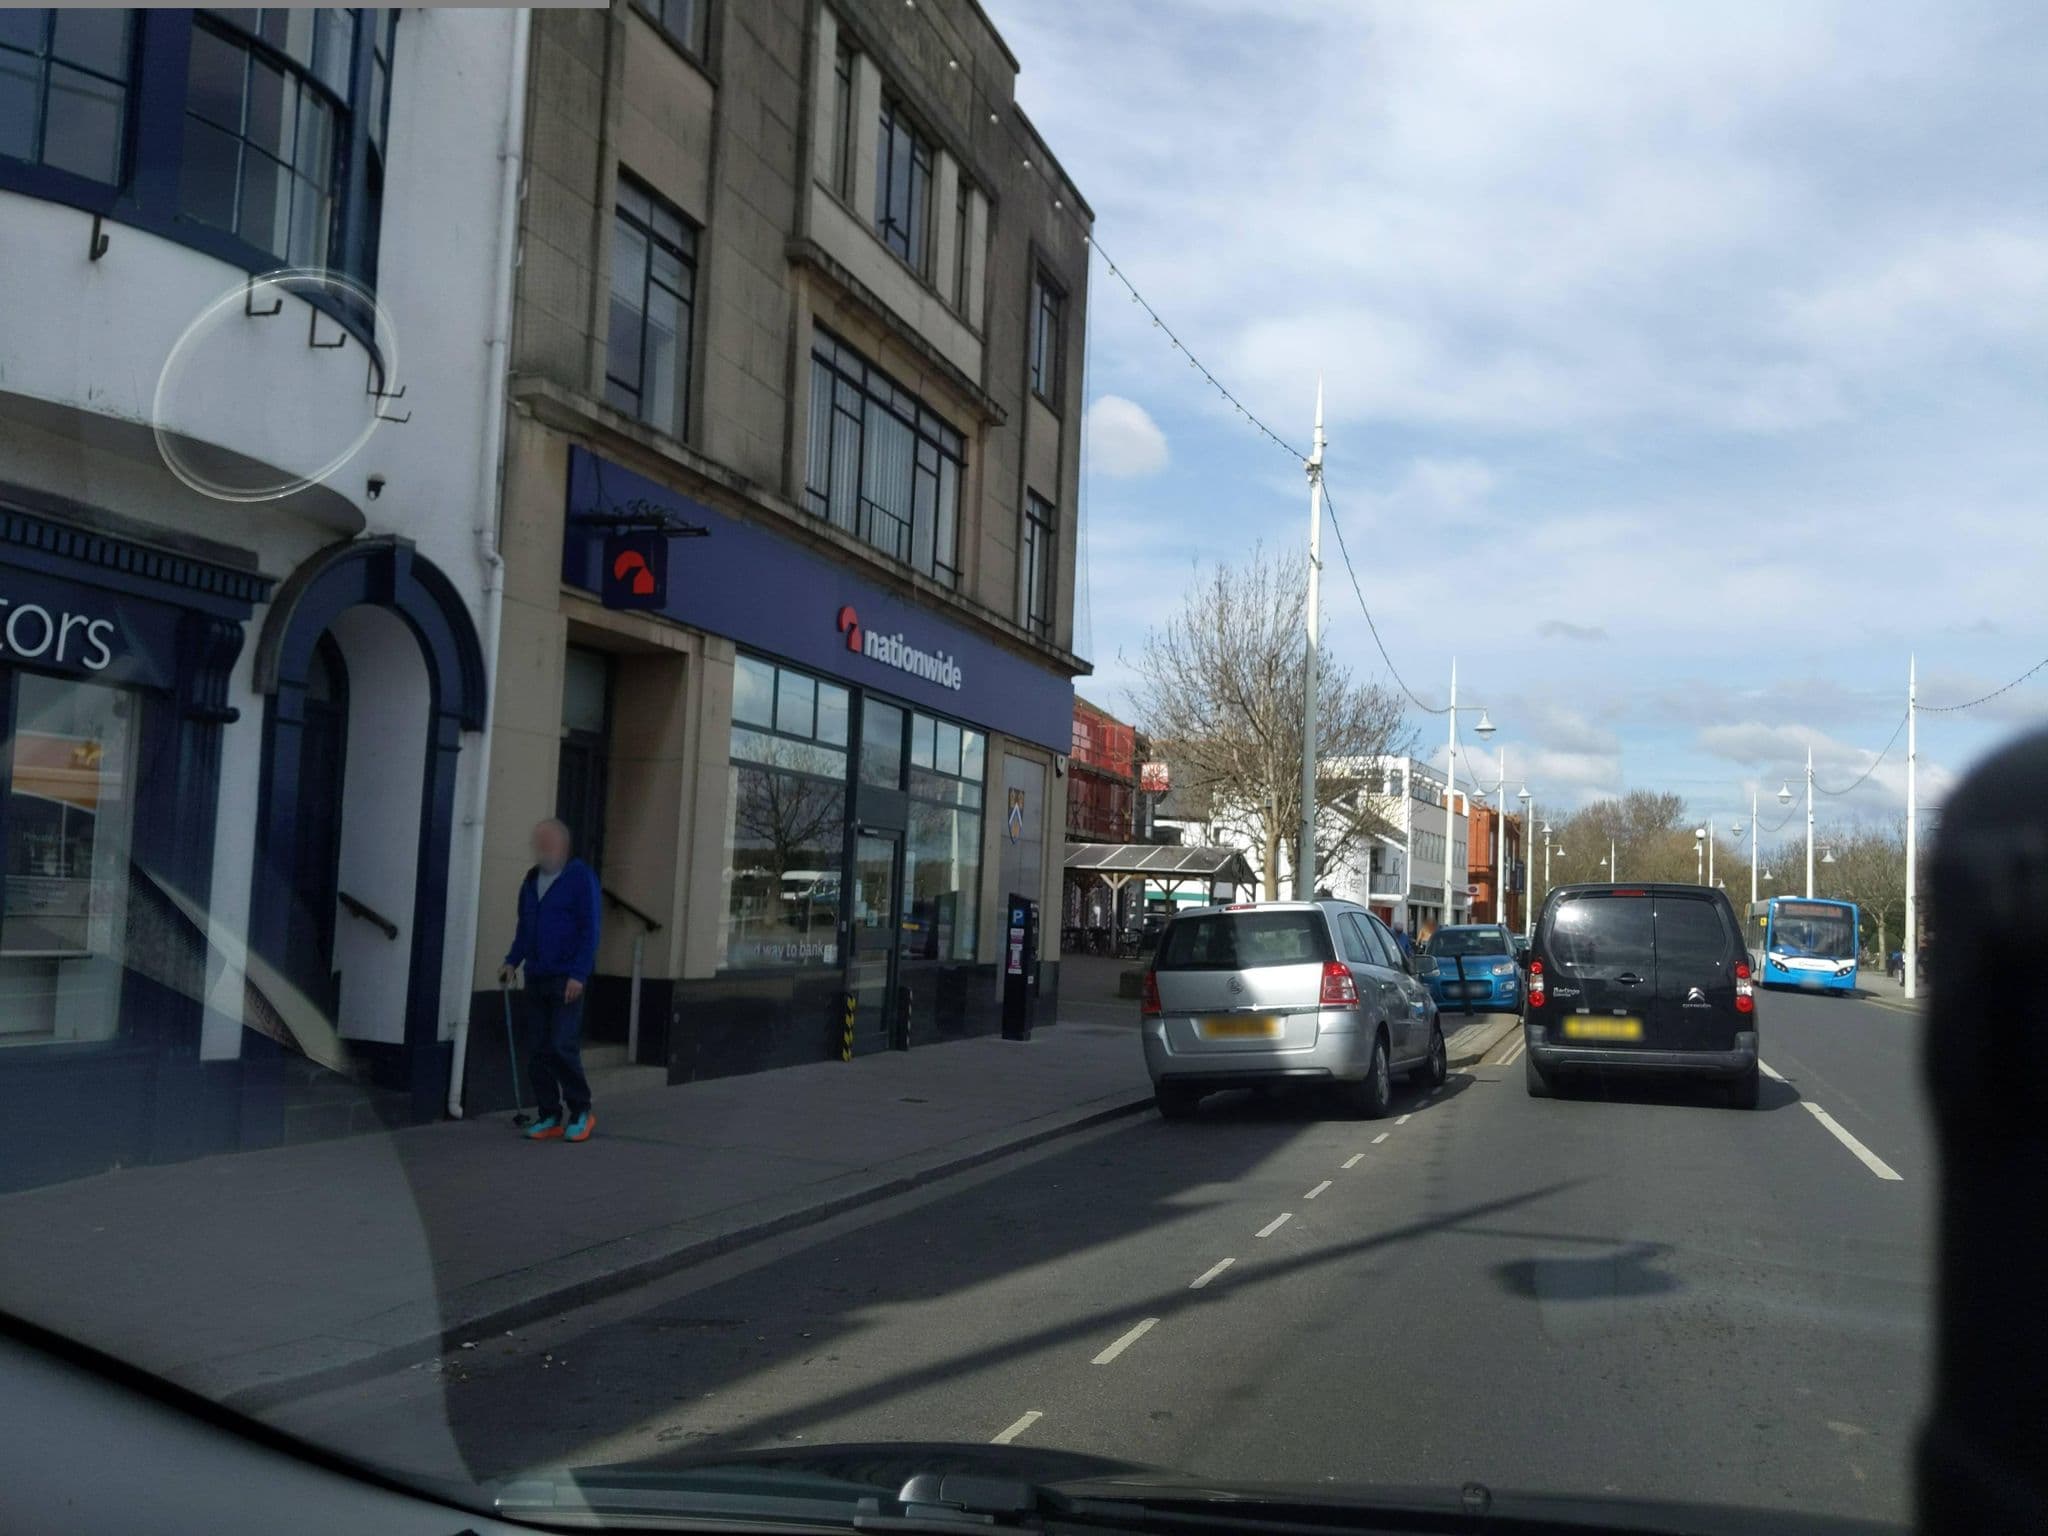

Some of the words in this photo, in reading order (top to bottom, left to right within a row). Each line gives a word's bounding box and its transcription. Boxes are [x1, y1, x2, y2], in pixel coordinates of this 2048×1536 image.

[0, 598, 114, 670] ors
[864, 630, 962, 690] nationwide
[1012, 909, 1024, 924] P
